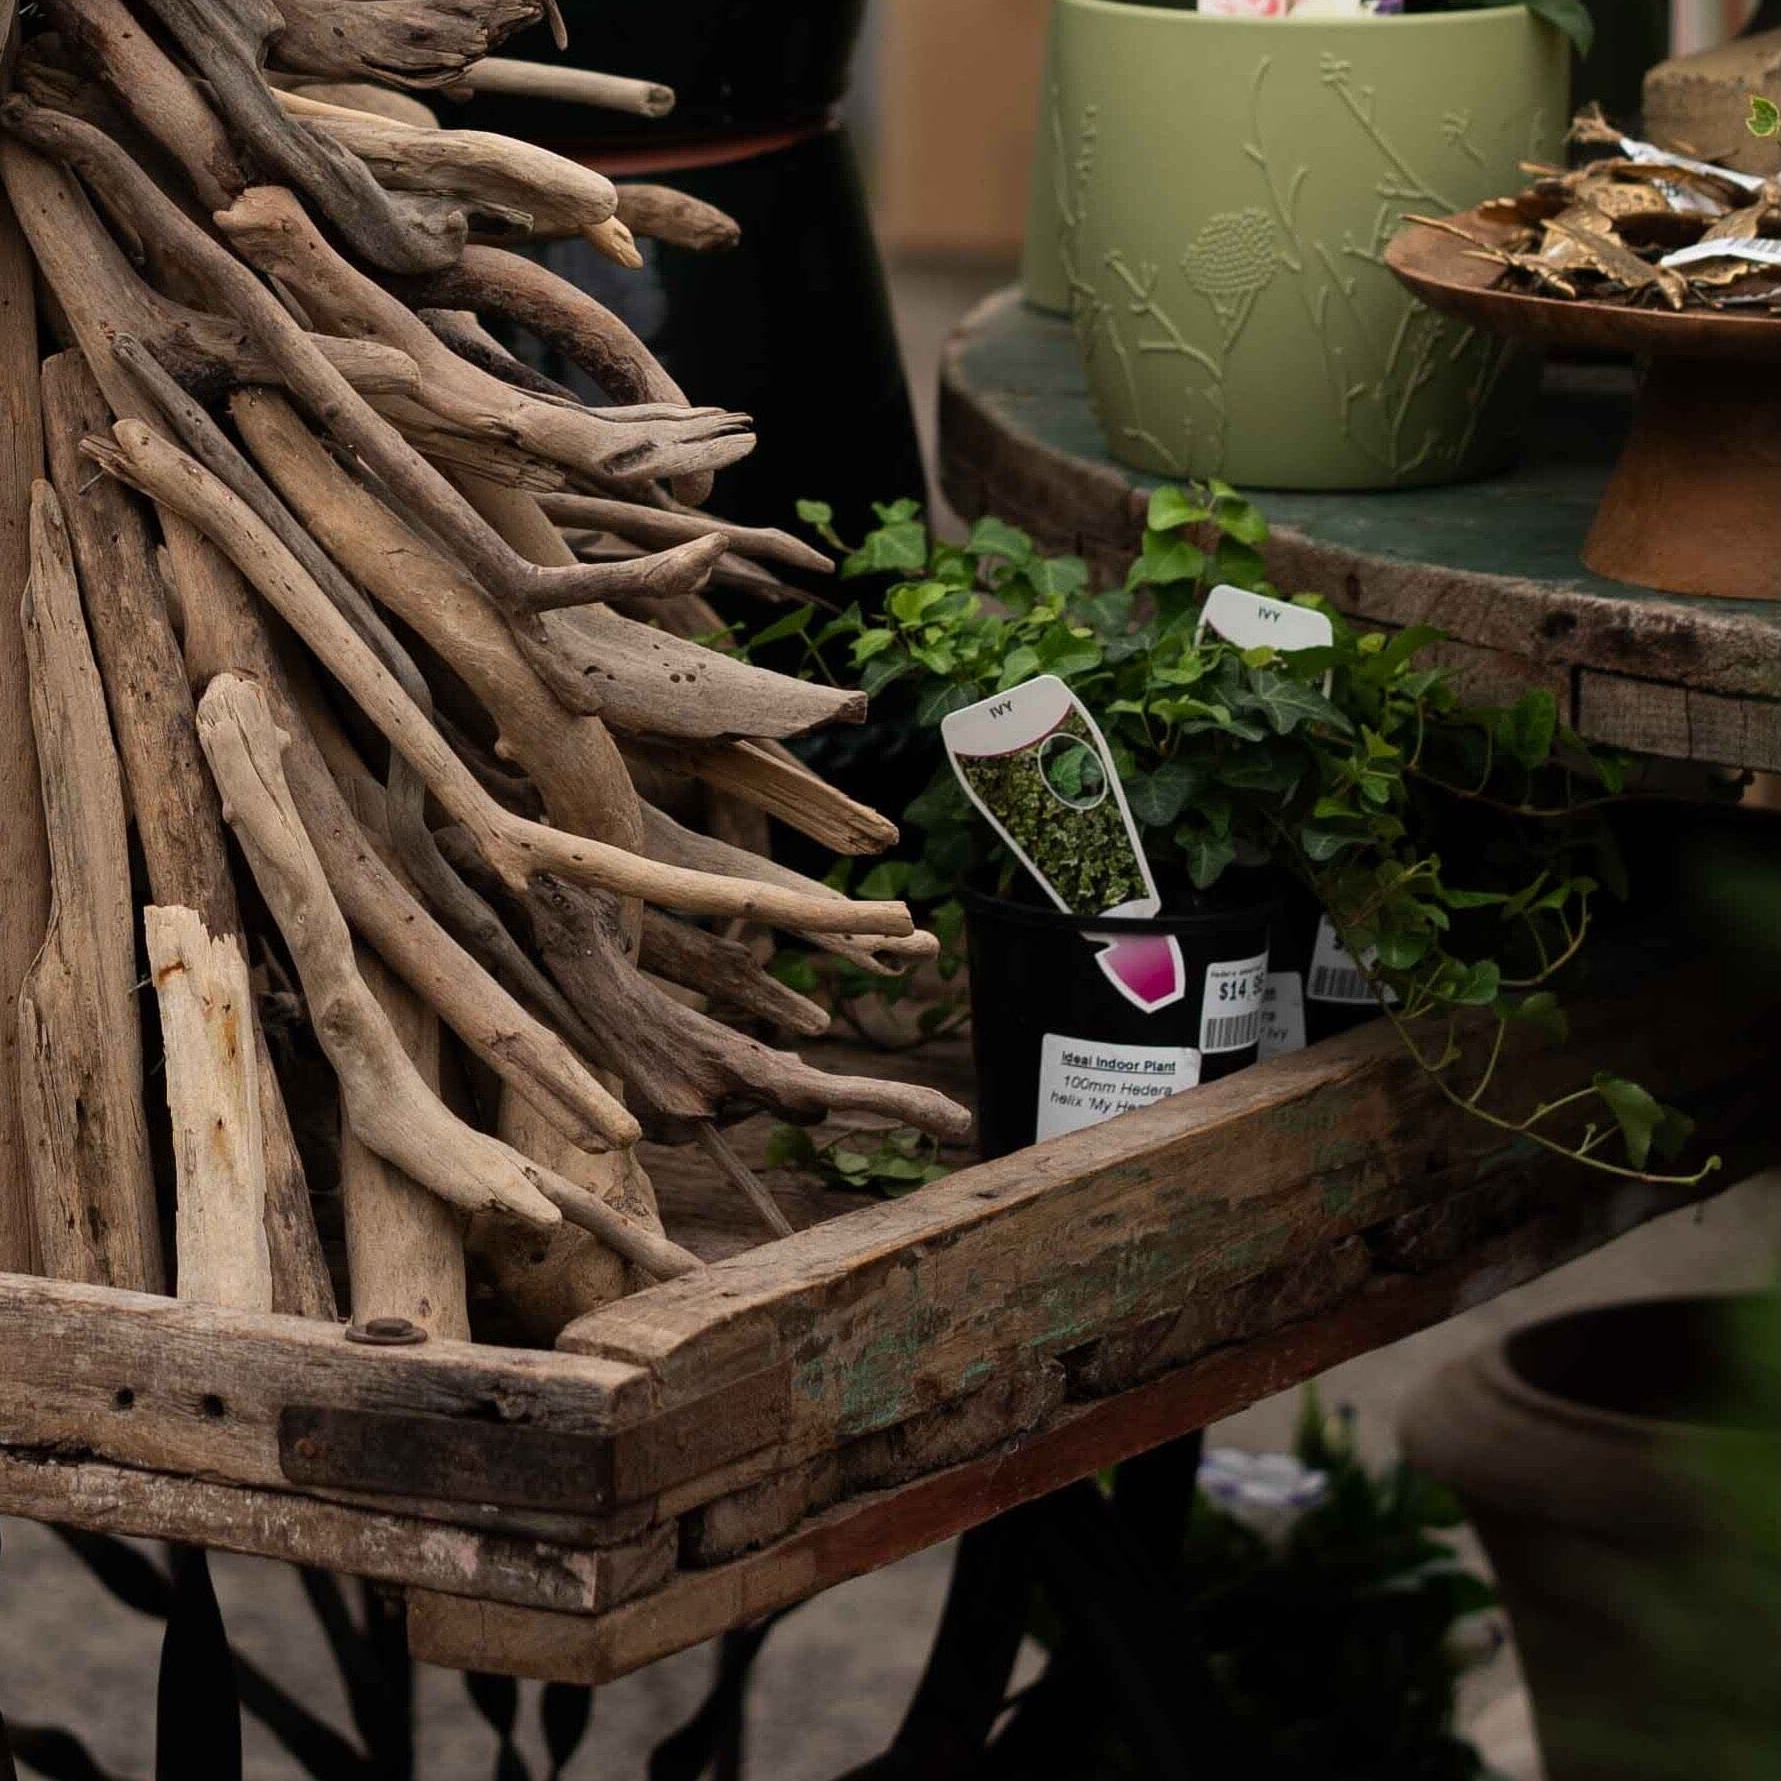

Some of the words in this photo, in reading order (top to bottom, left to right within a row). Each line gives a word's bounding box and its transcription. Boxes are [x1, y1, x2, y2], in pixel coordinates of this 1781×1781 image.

[1258, 606, 1281, 623] IVY
[989, 700, 1013, 718] IVY
[1060, 1050, 1093, 1068] Ideal
[1096, 1056, 1139, 1071] Indoor
[1144, 1060, 1176, 1073] Plant
[1063, 1075, 1116, 1093] 100mm
[1120, 1082, 1173, 1097] Hedera
[1050, 1091, 1083, 1107] helix
